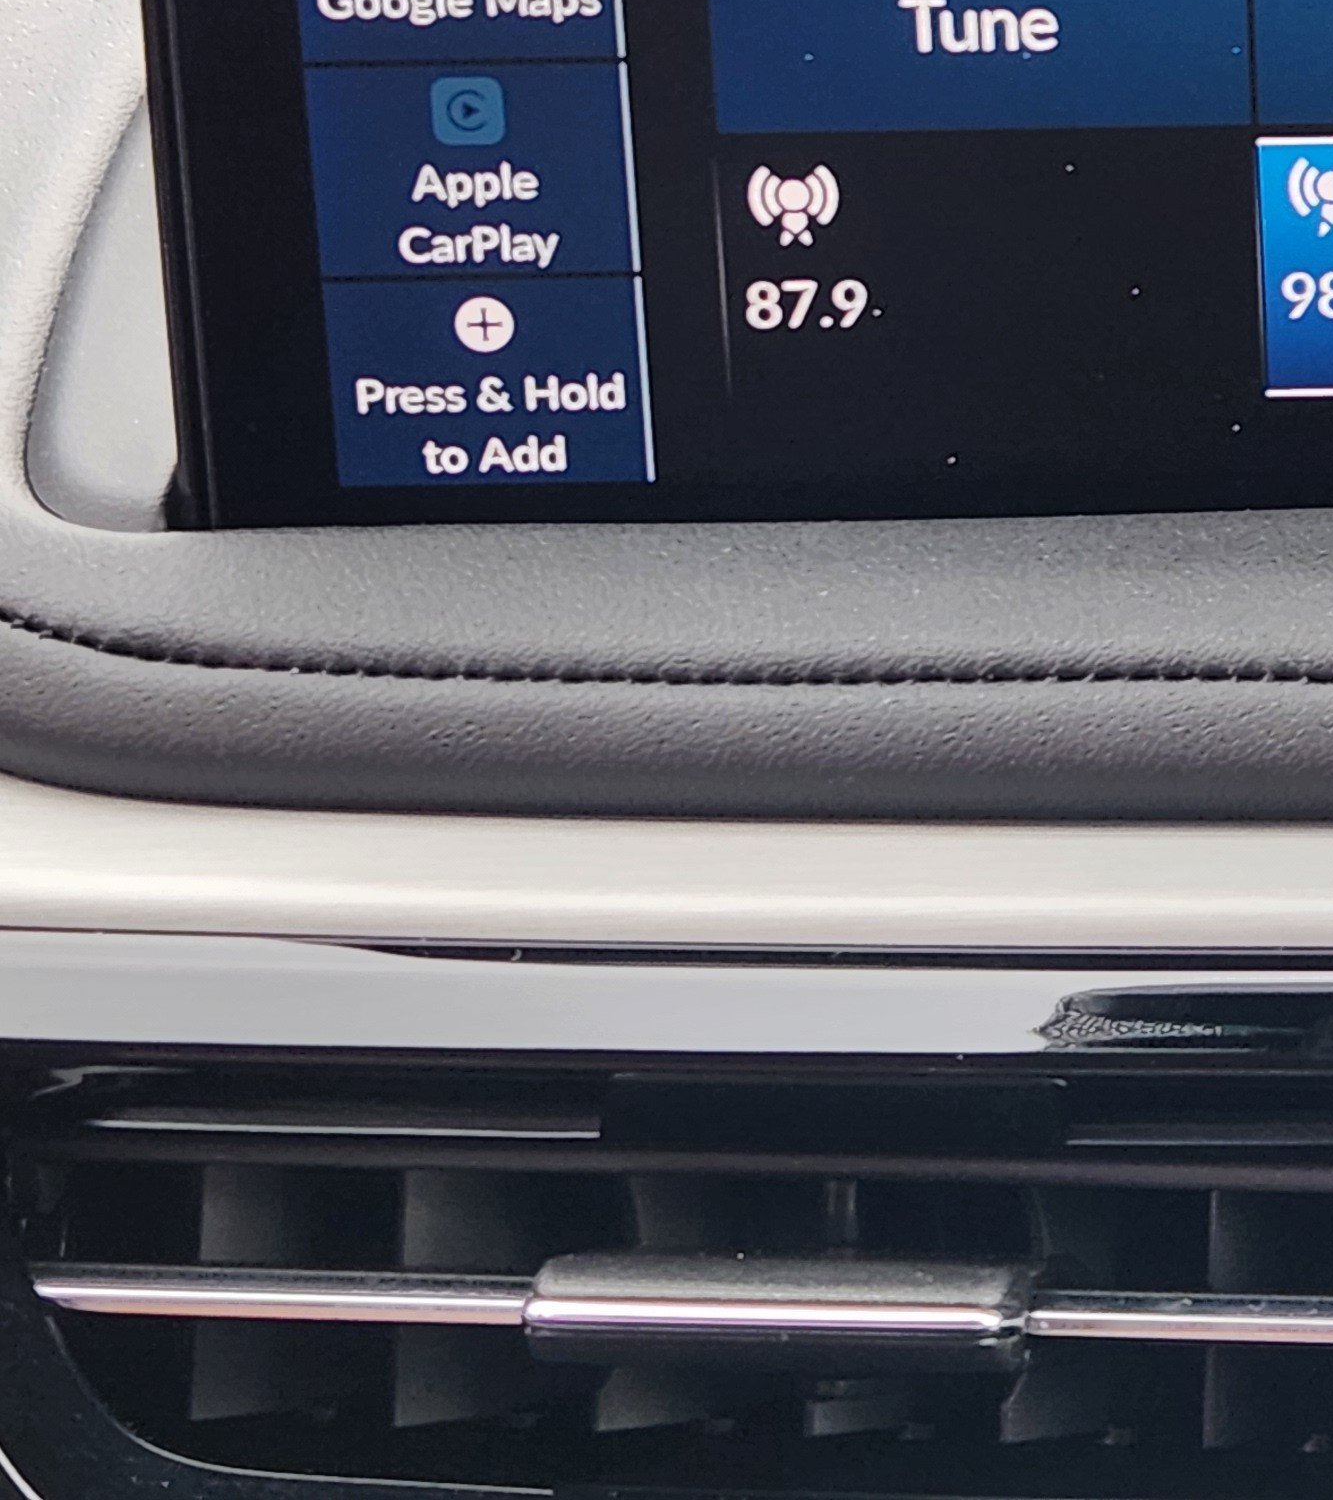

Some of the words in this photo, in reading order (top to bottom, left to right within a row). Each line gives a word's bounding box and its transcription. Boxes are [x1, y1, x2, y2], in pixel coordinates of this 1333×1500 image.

[411, 163, 541, 209] Apple
[397, 228, 559, 270] CarPlay
[744, 278, 870, 332] 87.9
[355, 379, 467, 417] Press
[478, 378, 514, 414] &
[523, 374, 627, 413] Hold
[423, 438, 469, 476] to
[479, 435, 567, 474] Add
